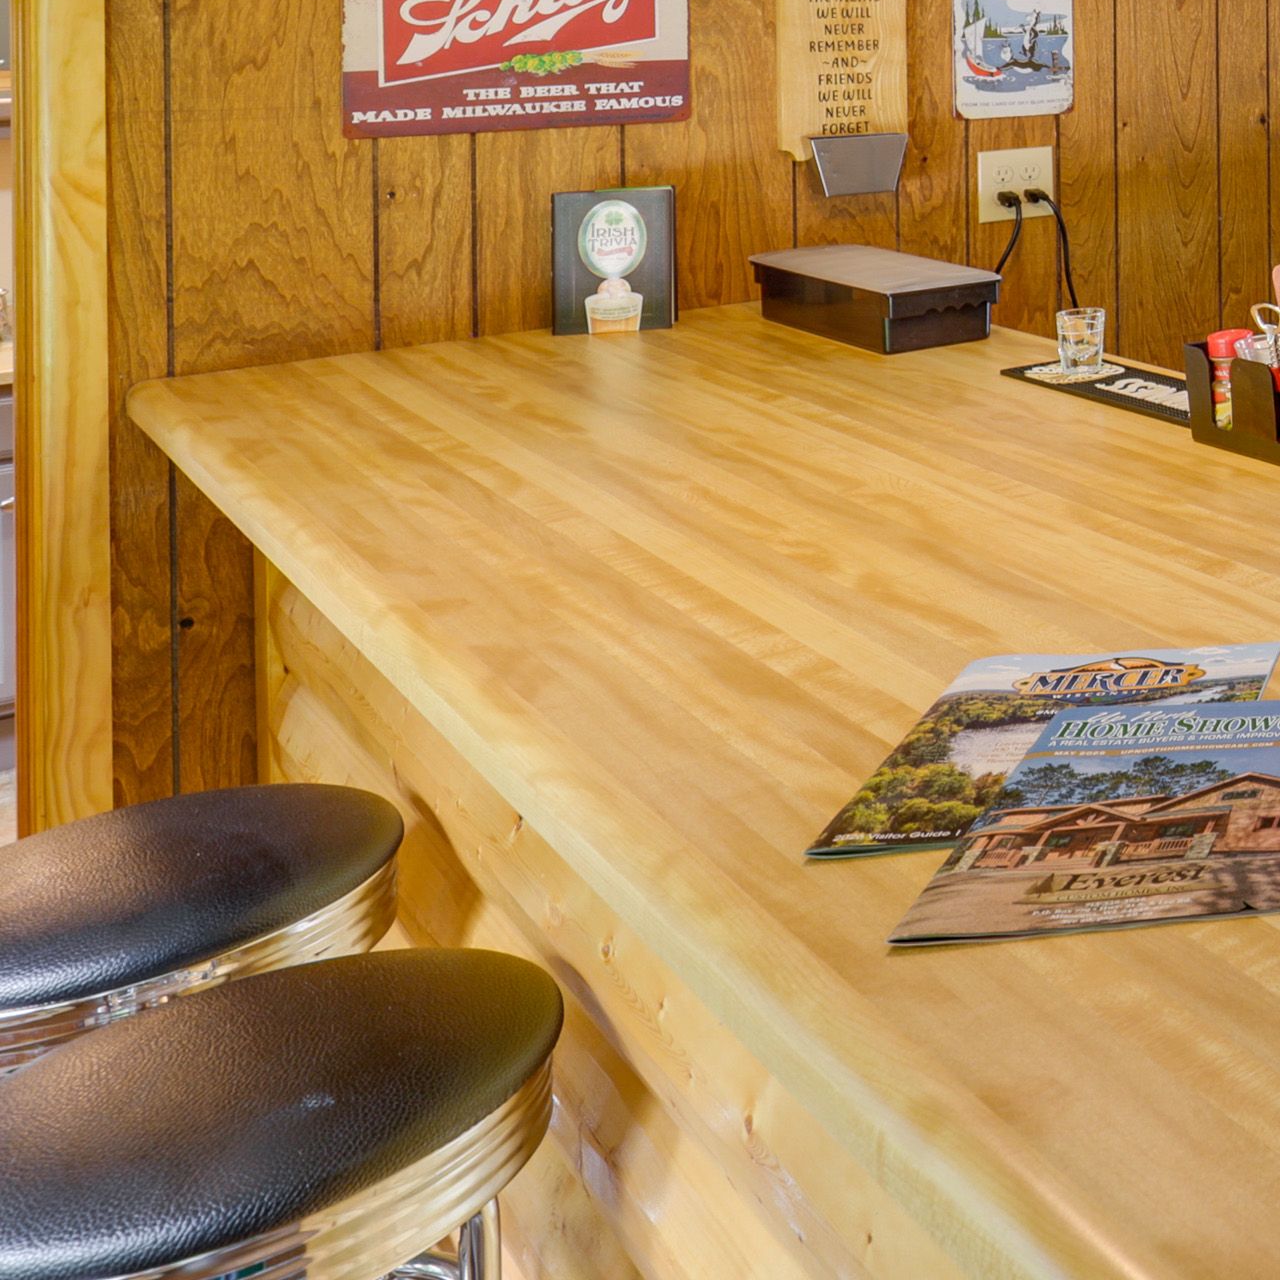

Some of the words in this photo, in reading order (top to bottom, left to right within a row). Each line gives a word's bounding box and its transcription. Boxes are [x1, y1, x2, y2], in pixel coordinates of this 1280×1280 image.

[817, 8, 837, 19] WE
[841, 7, 871, 19] WILL
[824, 23, 864, 35] NEVER
[810, 40, 879, 52] REMEMBER
[819, 72, 872, 85] FRIENDS
[464, 88, 512, 101] THE
[520, 85, 579, 97] BEER
[585, 81, 644, 94] THAT
[818, 90, 838, 102] WE
[843, 89, 872, 101] WILL
[352, 108, 432, 124] MADE
[442, 99, 586, 119] MILWAUKEE
[595, 96, 684, 110] FAMOUS
[826, 106, 866, 118] NEVER
[822, 121, 869, 135] FORGET
[591, 223, 635, 238] IRISH
[588, 237, 637, 252] TRIVIA
[1030, 669, 1184, 692] MERCER
[1052, 689, 1149, 699] WISCONSIN
[1050, 720, 1167, 740] HOME
[1139, 735, 1185, 744] BUYERS
[1061, 865, 1210, 890] Everest
